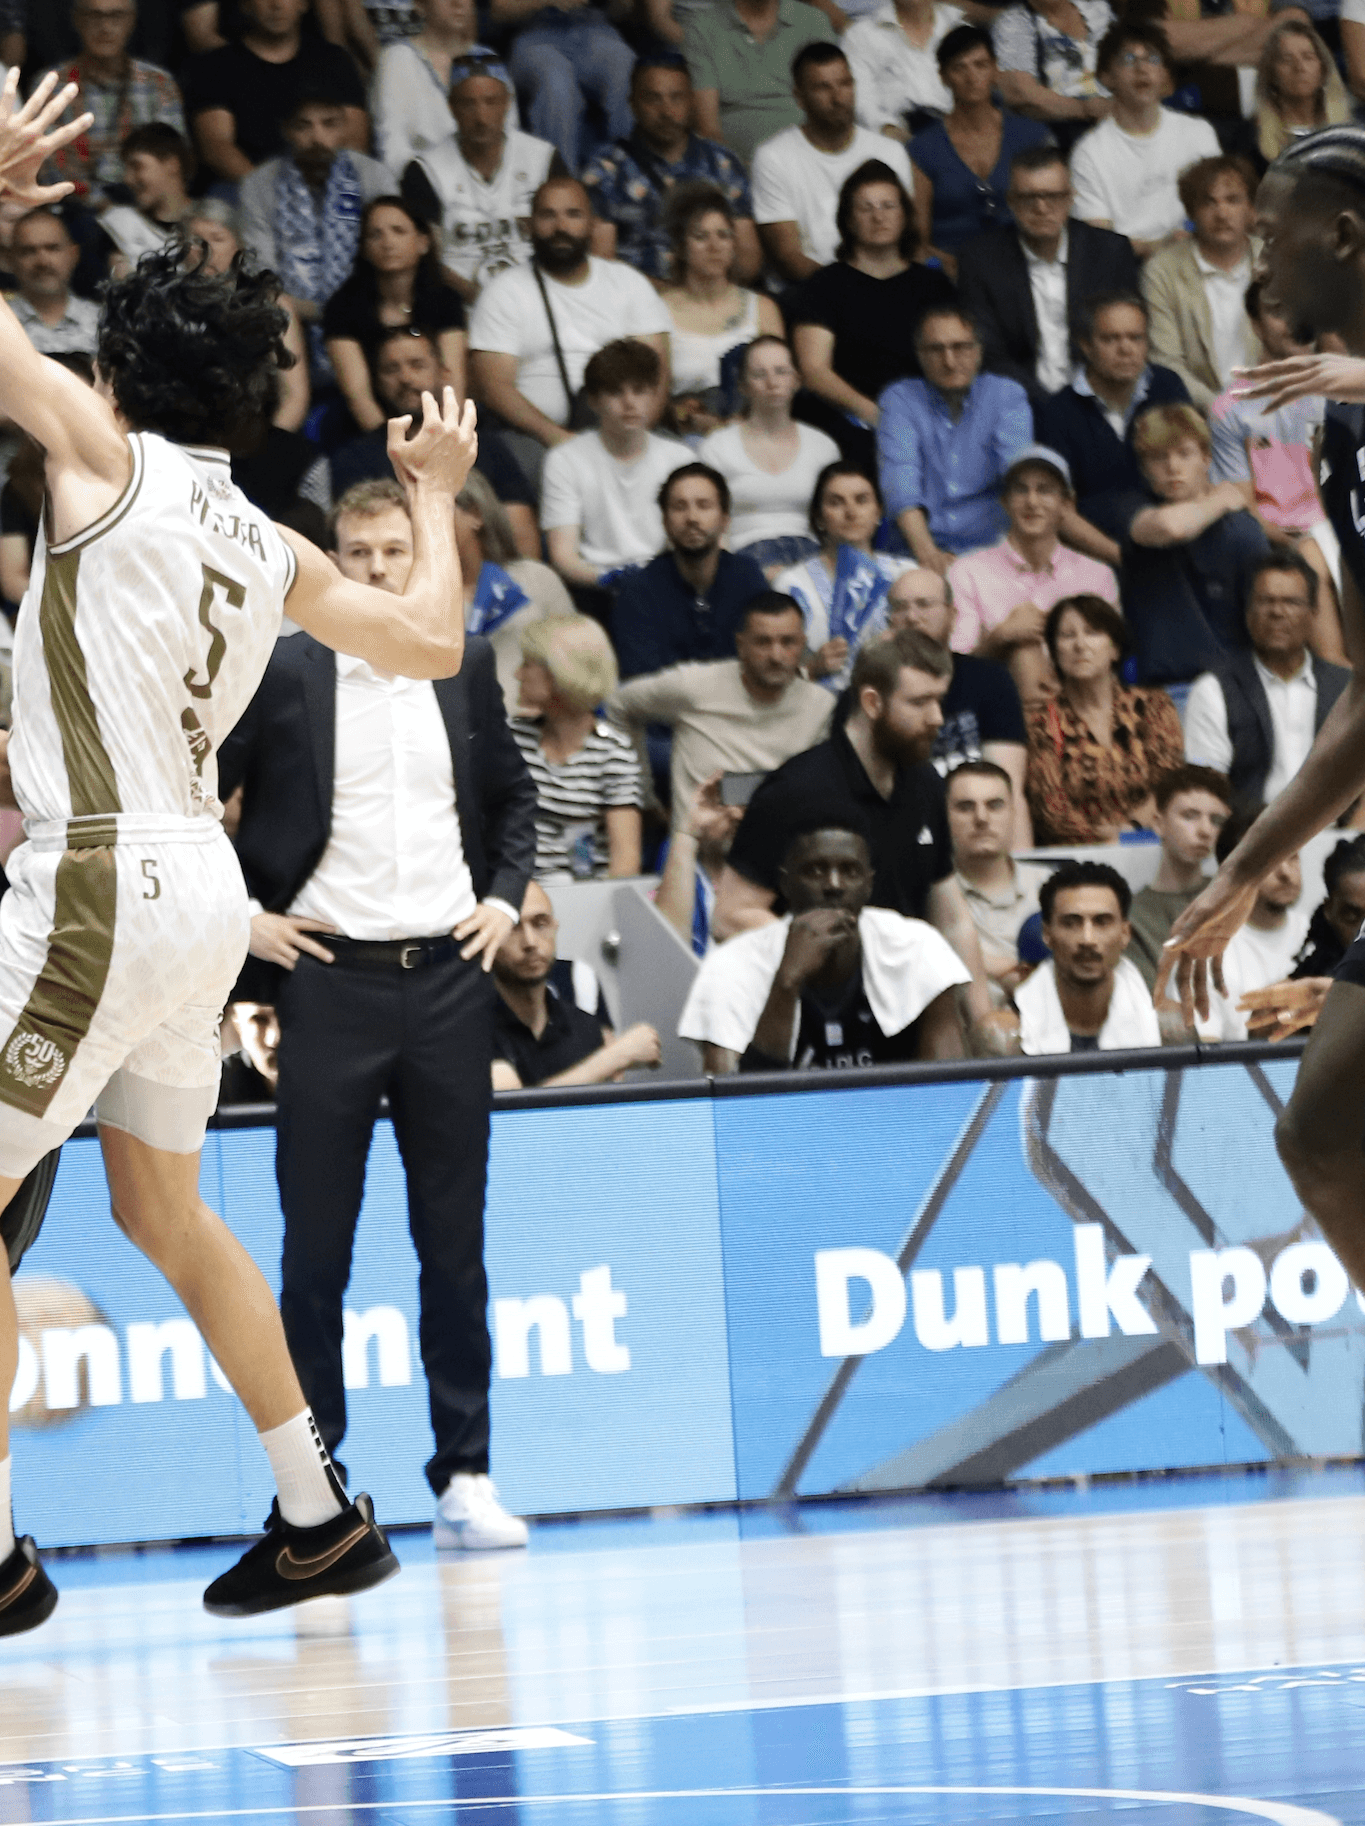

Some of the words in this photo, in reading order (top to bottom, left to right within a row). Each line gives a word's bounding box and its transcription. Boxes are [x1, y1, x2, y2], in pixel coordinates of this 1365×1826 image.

[183, 562, 247, 699] 5
[141, 860, 161, 900] 5
[25, 1033, 57, 1063] 50
[814, 1222, 1159, 1358] Dunk
